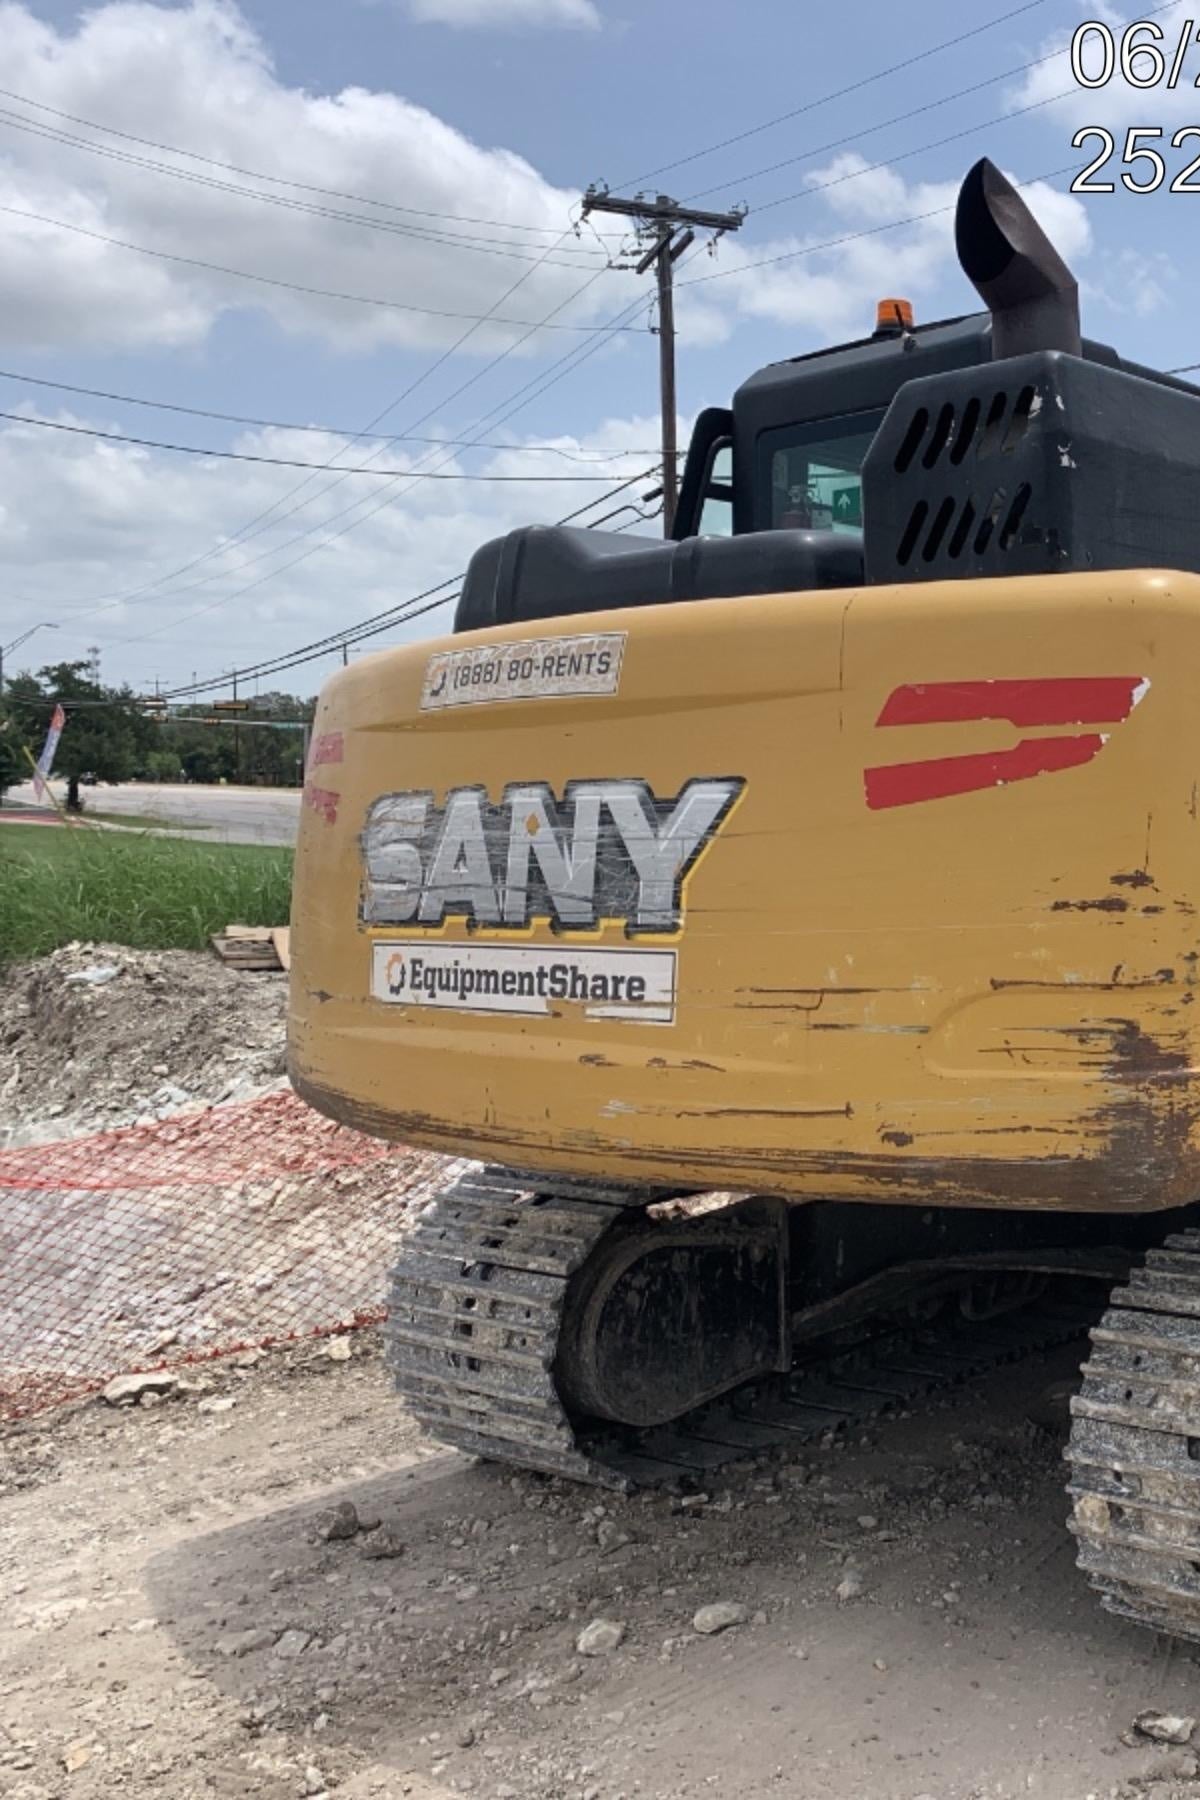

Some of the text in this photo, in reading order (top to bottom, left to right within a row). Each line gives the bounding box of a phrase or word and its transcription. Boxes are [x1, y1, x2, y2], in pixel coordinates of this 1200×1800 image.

[453, 651, 611, 690] (888) 80-RENTS
[361, 777, 746, 935] SANY
[409, 958, 646, 1001] EquipmentShare
